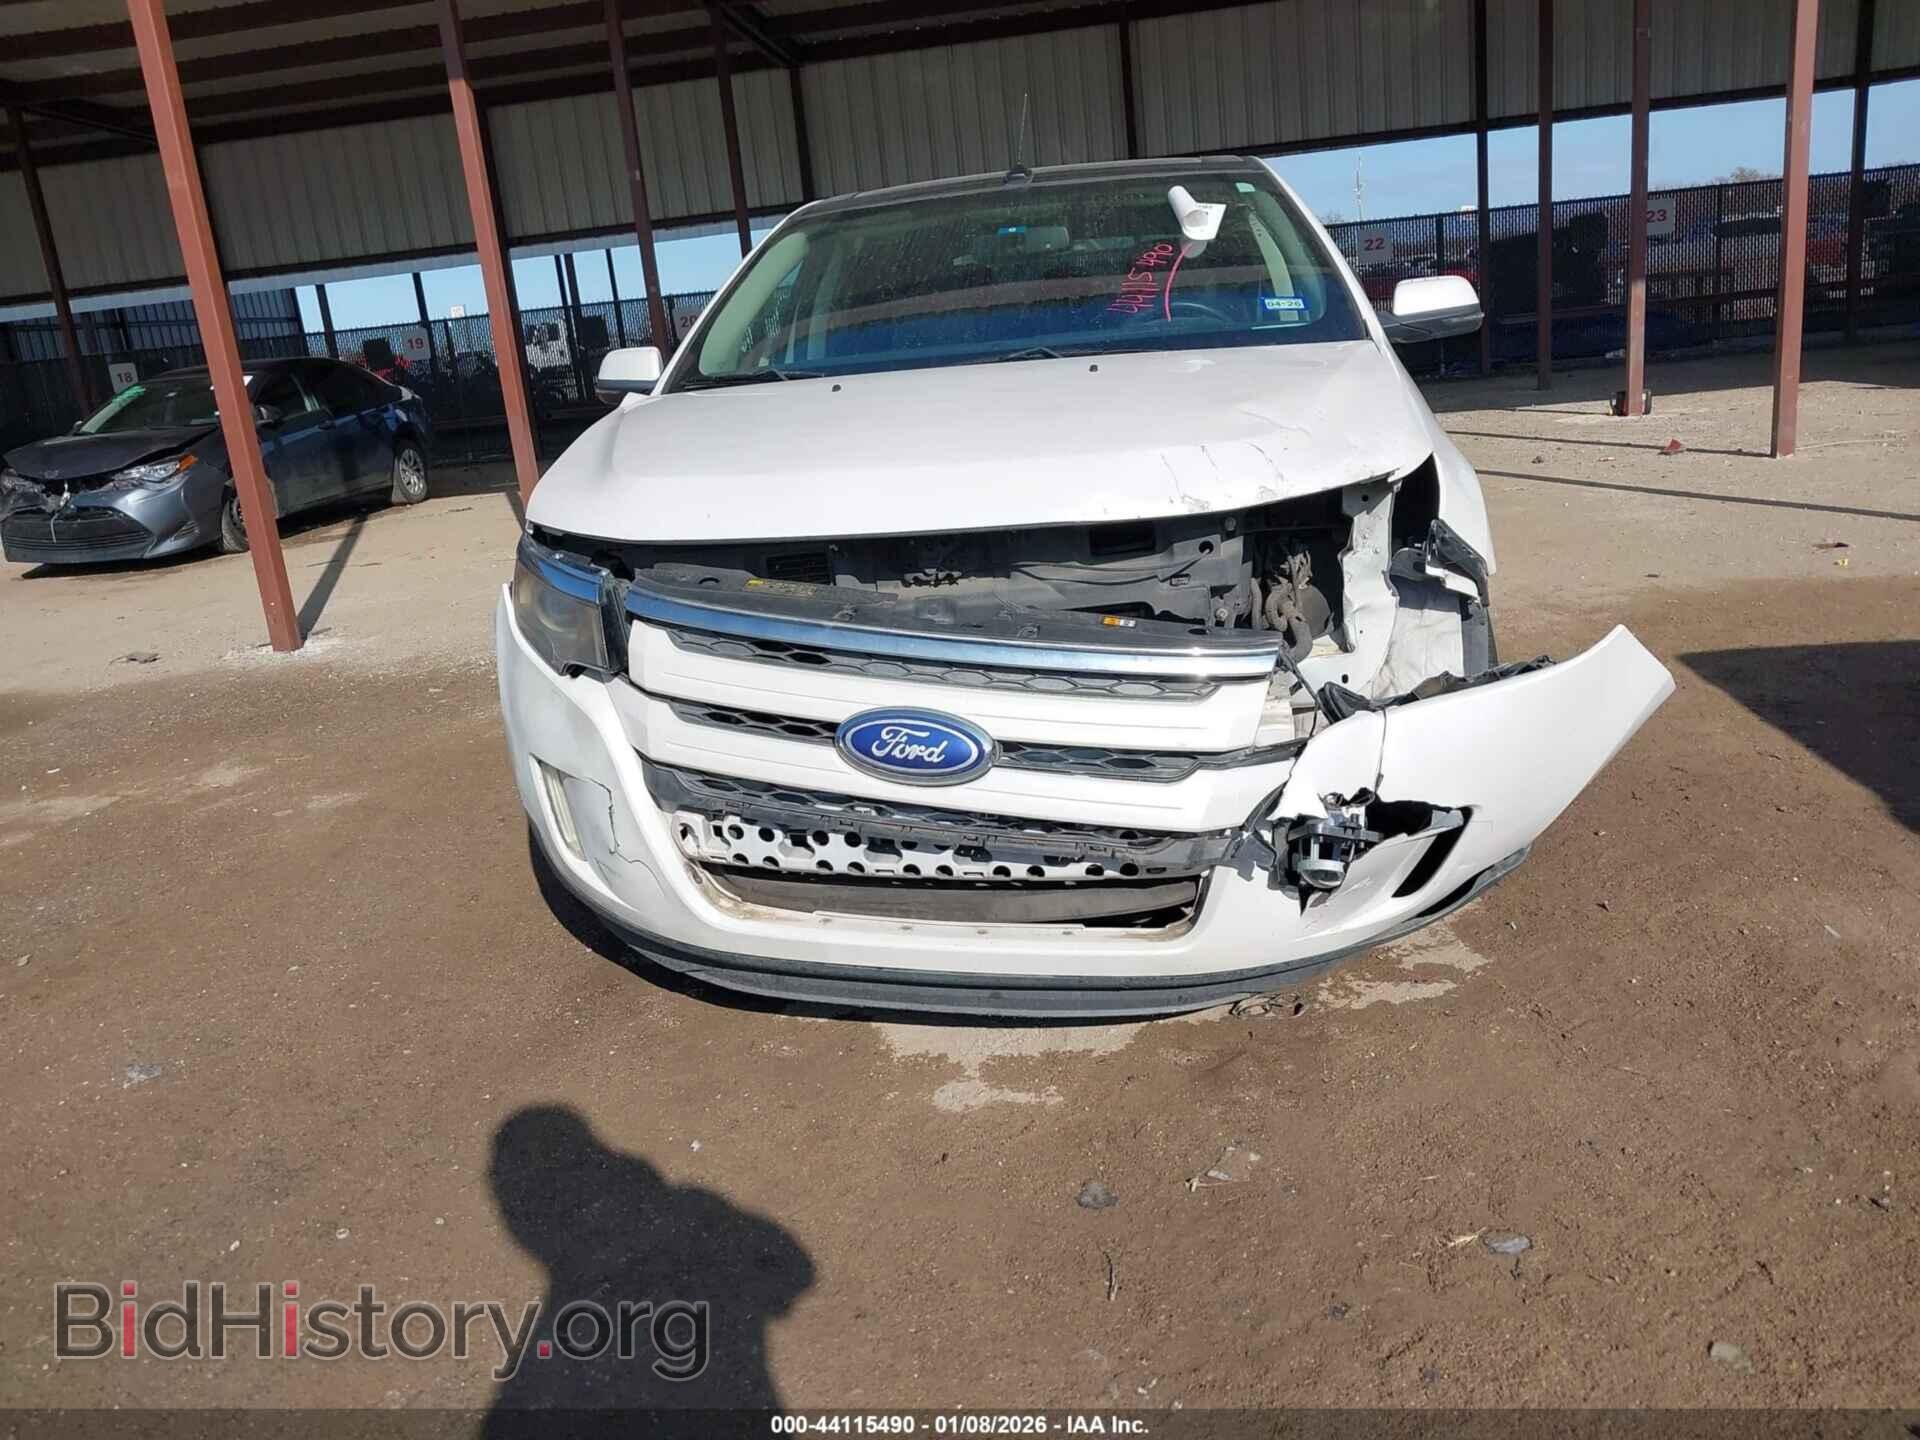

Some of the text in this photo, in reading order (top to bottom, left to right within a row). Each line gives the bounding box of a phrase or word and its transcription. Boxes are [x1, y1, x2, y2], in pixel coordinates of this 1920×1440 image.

[1646, 208, 1667, 224] 23
[1364, 238, 1385, 252] 22
[407, 337, 425, 351] 19
[117, 371, 134, 384] 18
[871, 726, 949, 764] Ford
